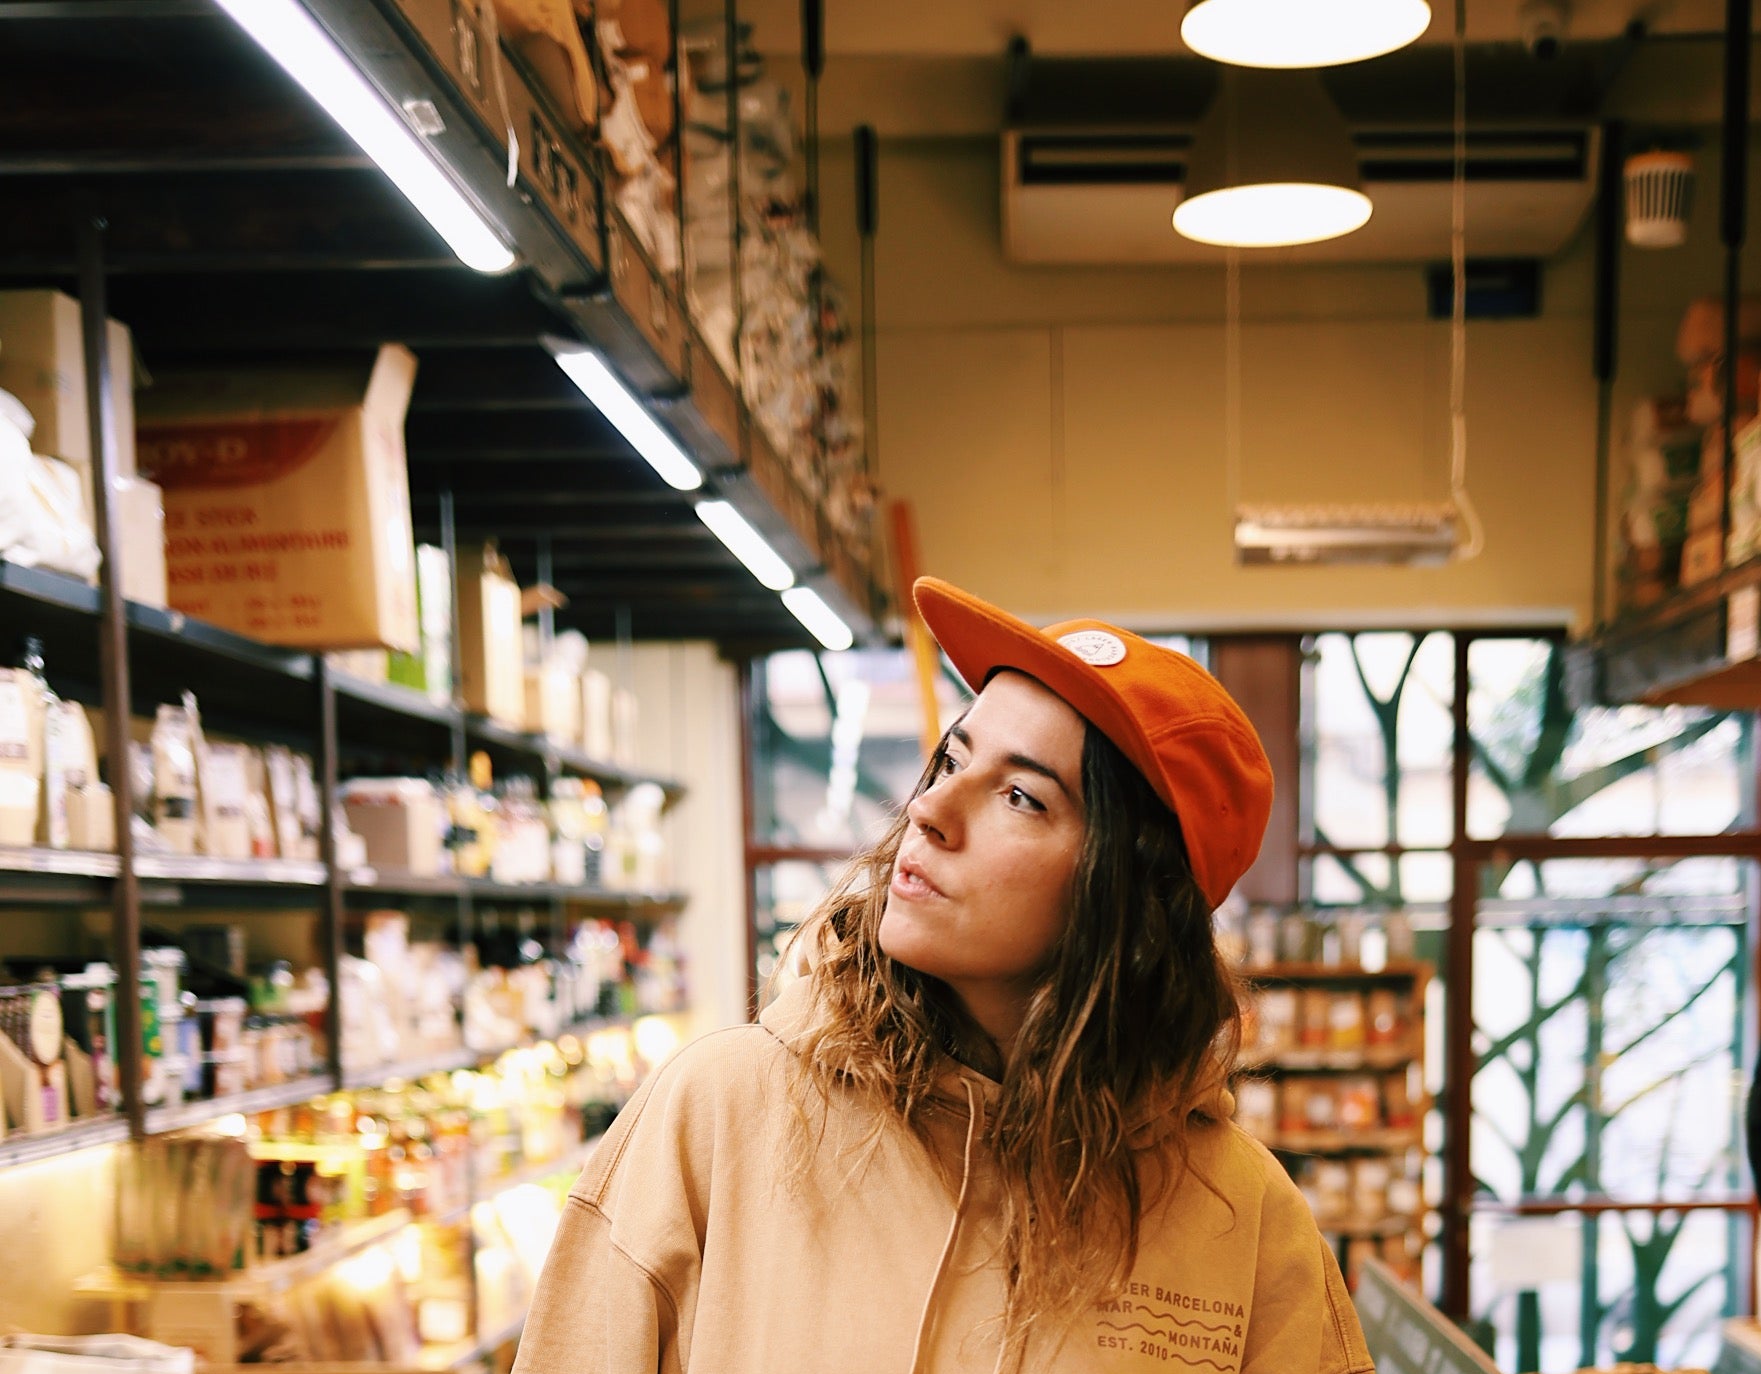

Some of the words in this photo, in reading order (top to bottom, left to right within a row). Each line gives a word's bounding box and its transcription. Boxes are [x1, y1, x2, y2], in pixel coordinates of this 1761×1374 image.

[1156, 1287, 1244, 1319] BARCELONA
[1168, 1330, 1239, 1358] MONTAÑA
[1234, 1324, 1242, 1338] &
[1097, 1335, 1133, 1351] EST.
[1140, 1341, 1168, 1361] 2010
